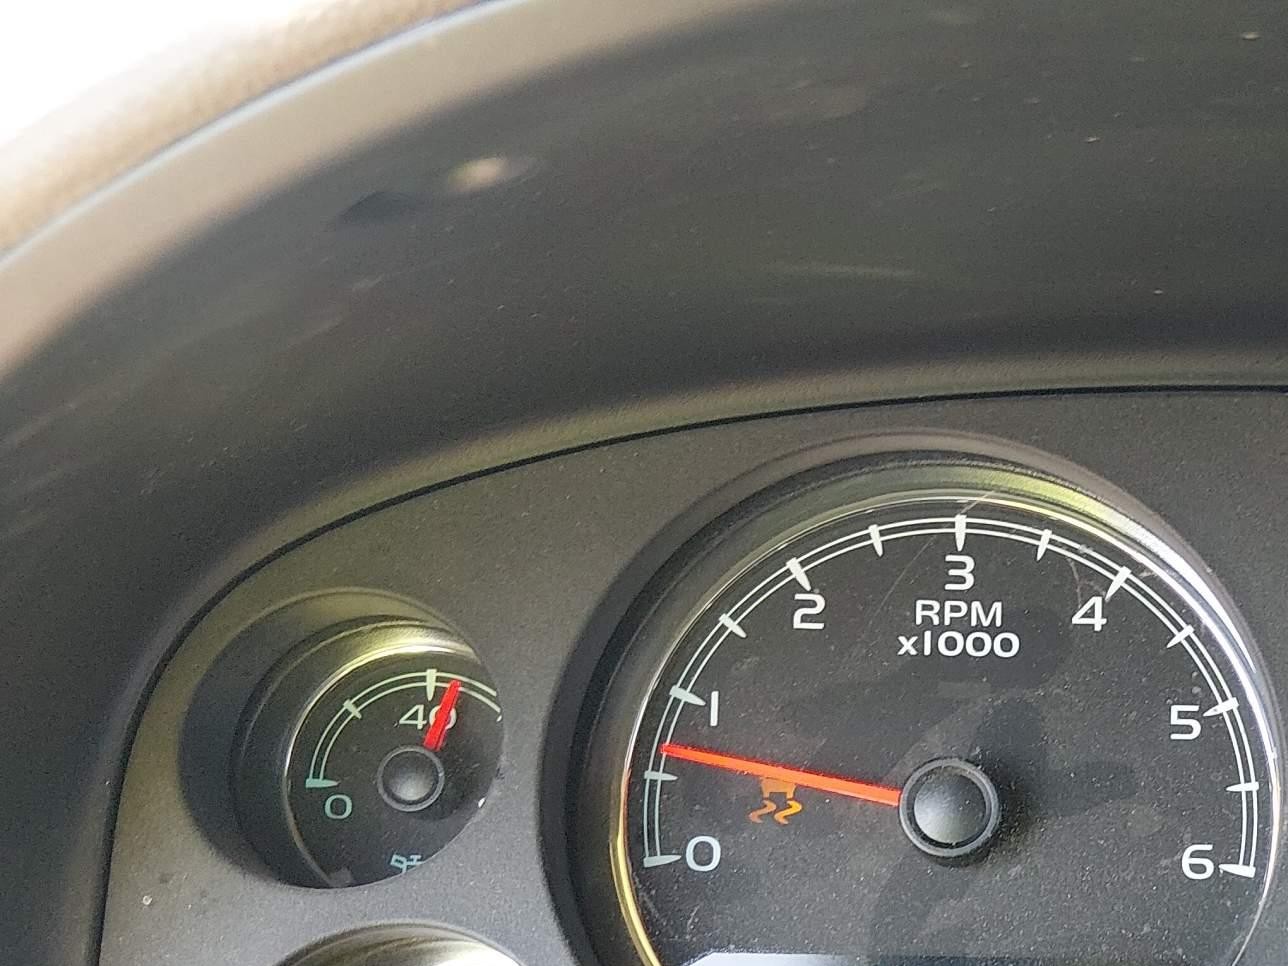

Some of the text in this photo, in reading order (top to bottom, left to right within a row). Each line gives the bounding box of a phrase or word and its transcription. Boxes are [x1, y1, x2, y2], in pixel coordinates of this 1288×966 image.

[944, 554, 976, 590] 3
[792, 593, 826, 630] 2
[915, 601, 1003, 626] RPM
[1071, 597, 1107, 632] 4
[897, 633, 1020, 657] x1000
[399, 704, 457, 730] 40
[709, 691, 719, 726] 1
[1169, 705, 1202, 740] 5
[325, 794, 353, 819] 0
[686, 836, 721, 872] 0
[1181, 845, 1215, 881] 6
